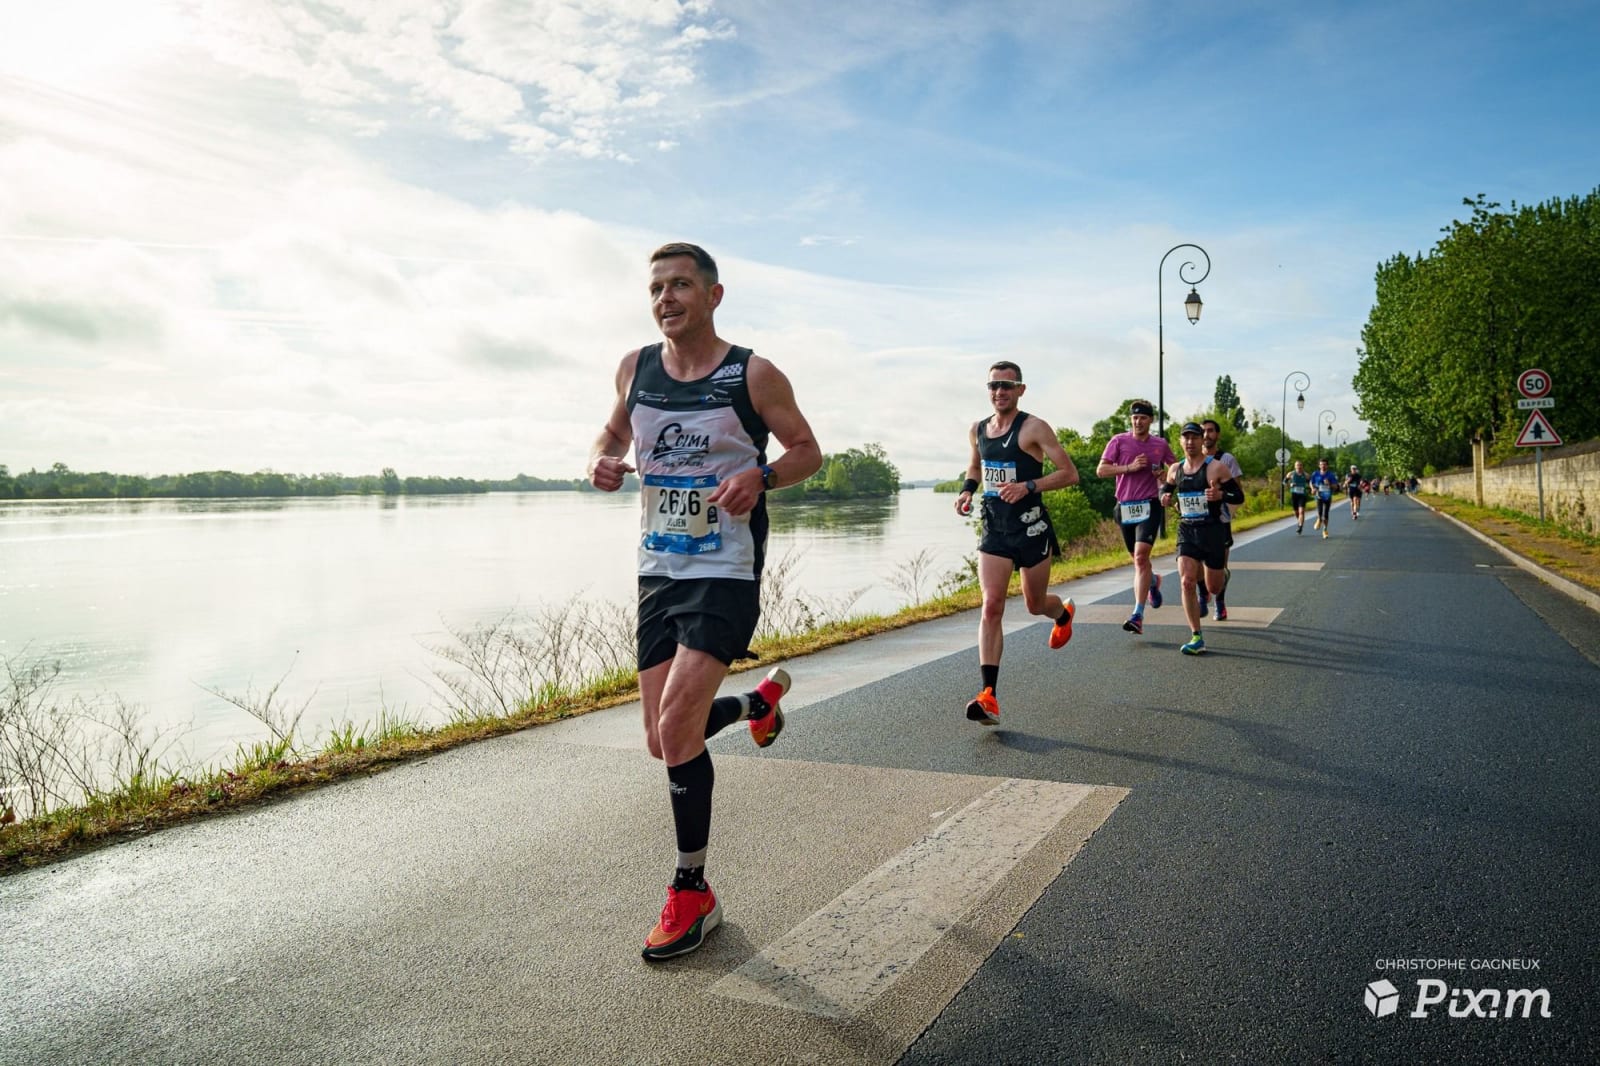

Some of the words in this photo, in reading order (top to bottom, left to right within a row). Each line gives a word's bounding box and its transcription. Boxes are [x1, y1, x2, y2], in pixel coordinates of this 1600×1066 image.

[1526, 378, 1545, 391] 50
[675, 434, 710, 449] CIMA
[985, 467, 1006, 483] 2730
[1183, 496, 1200, 508] 1544
